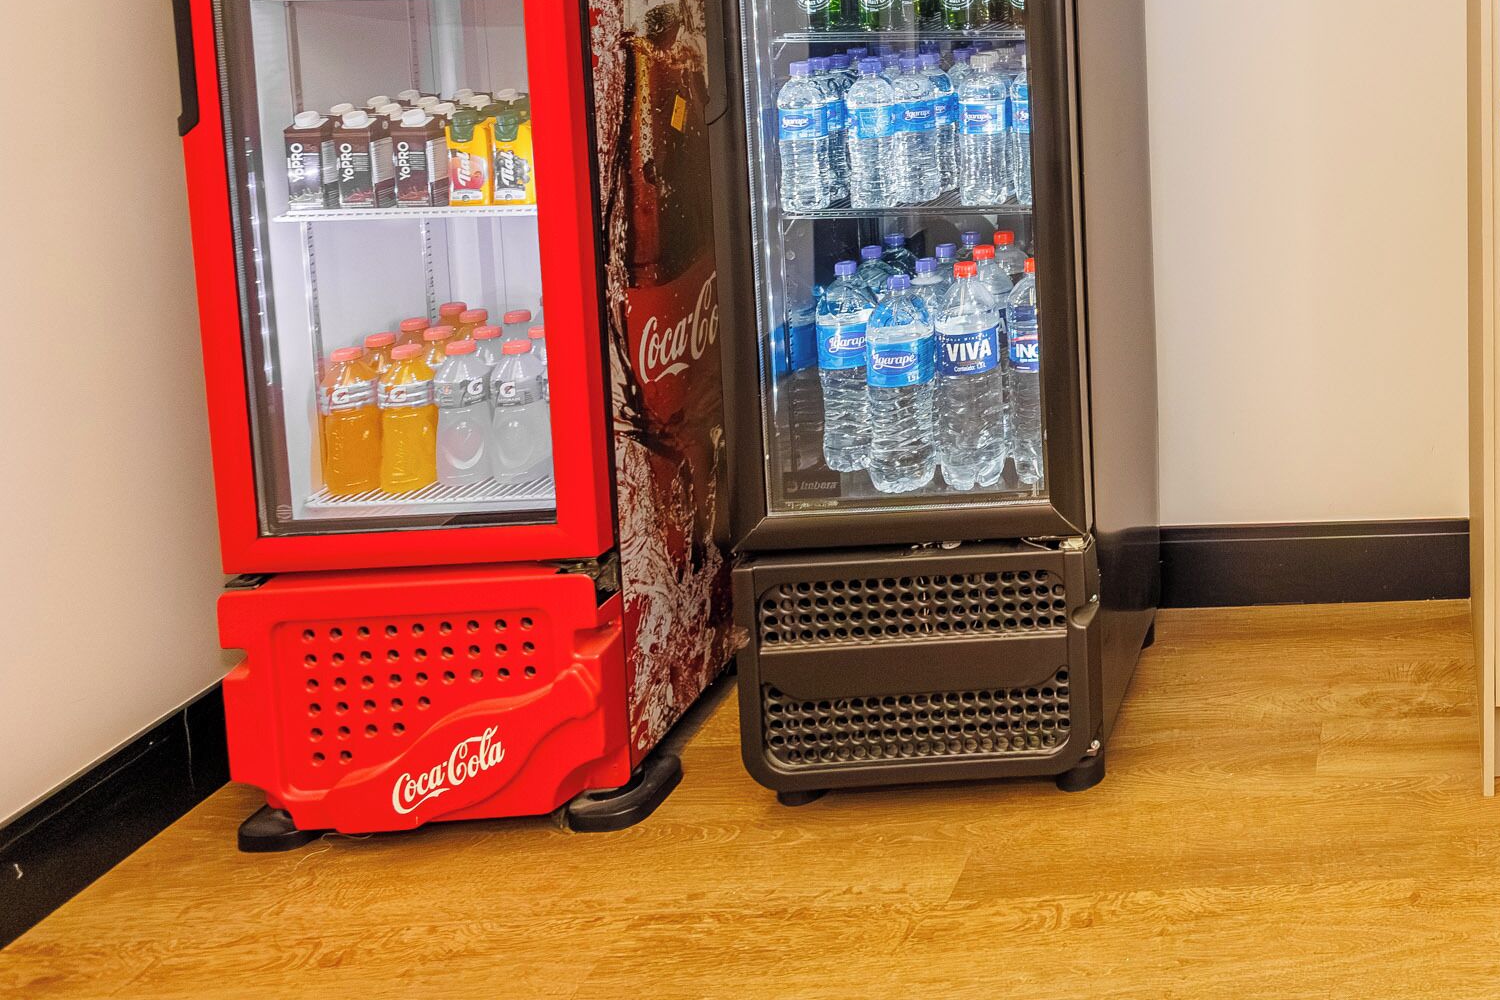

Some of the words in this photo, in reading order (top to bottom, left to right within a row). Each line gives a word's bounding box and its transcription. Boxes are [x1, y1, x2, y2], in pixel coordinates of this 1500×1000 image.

[290, 142, 305, 183] YoPRO
[340, 142, 355, 183] YoPRO
[397, 141, 411, 182] YoPRO
[639, 270, 719, 384] Coca-Co
[828, 335, 867, 354] Igarap
[946, 339, 992, 362] VIVA
[392, 725, 506, 815] Coca-Cola
